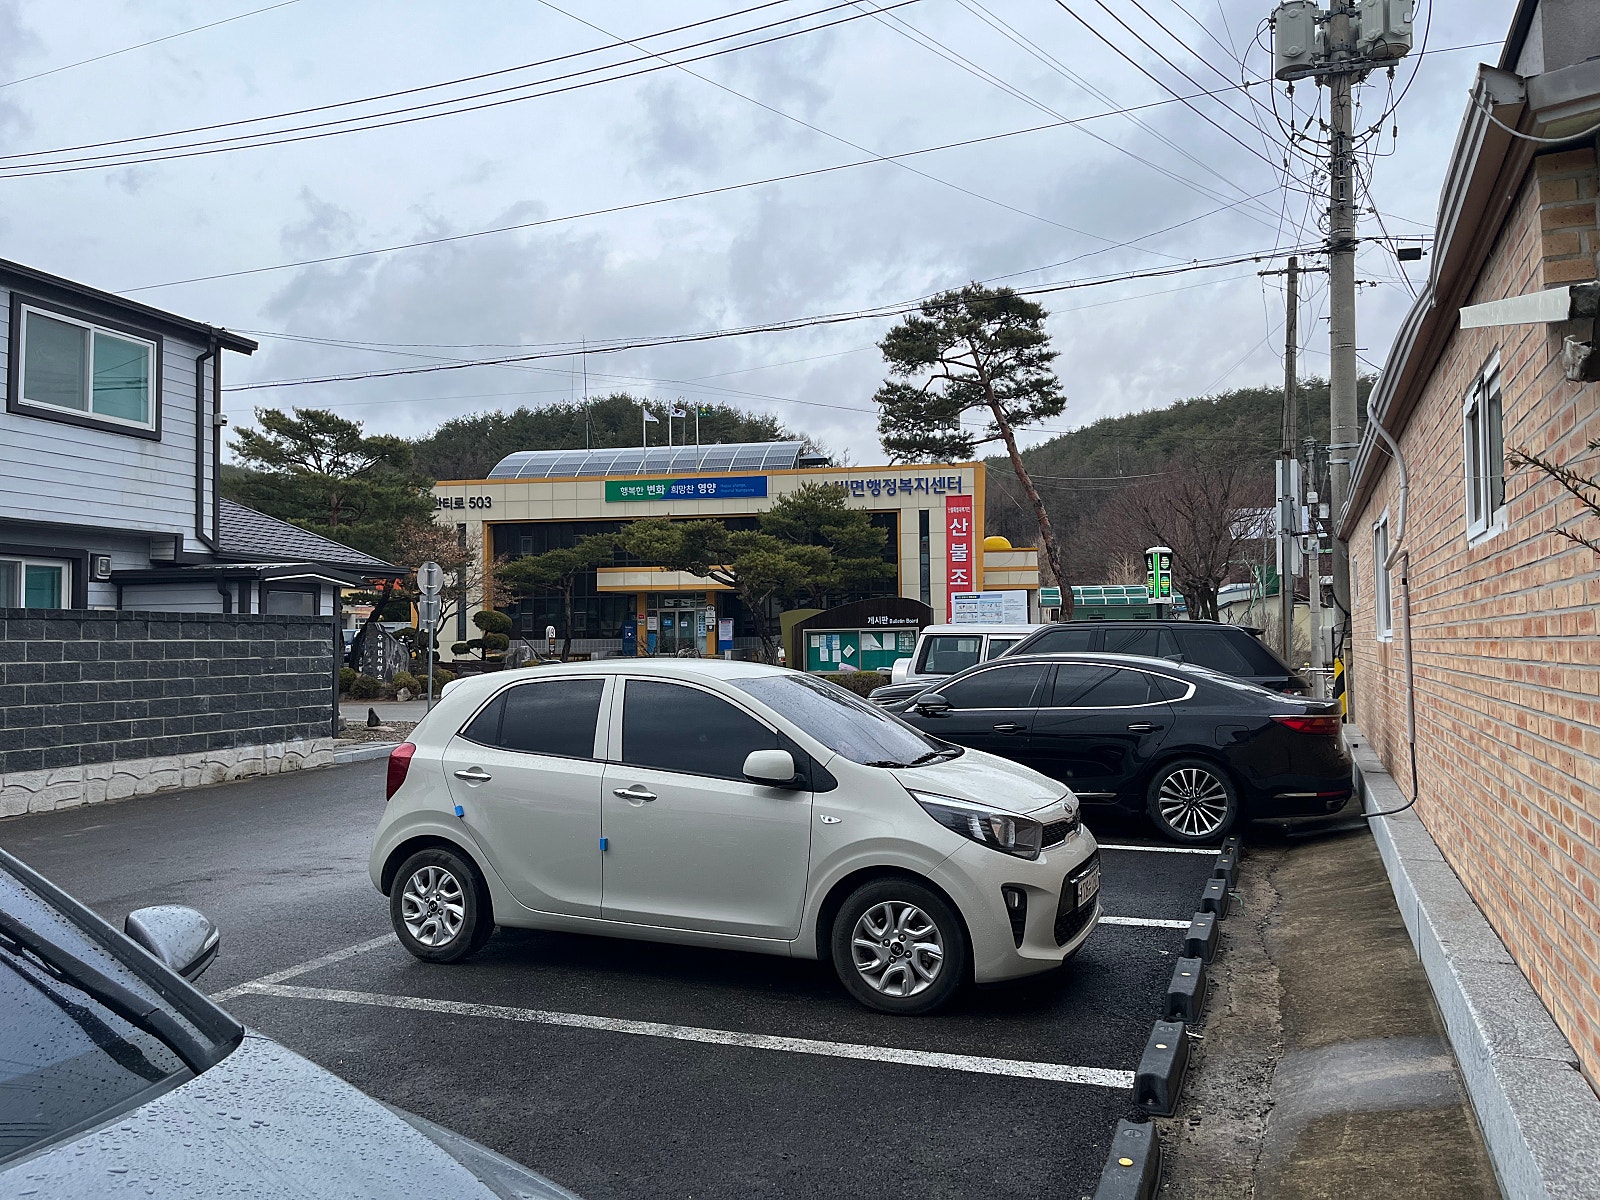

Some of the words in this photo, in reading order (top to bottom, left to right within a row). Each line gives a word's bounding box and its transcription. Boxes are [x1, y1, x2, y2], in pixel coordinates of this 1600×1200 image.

[620, 486, 644, 496] 행복한
[646, 484, 665, 495] 변화
[670, 484, 695, 494] 희망찬
[697, 482, 717, 494] 영양
[823, 475, 962, 498] 면행정복지센터
[468, 496, 492, 509] 503
[867, 615, 889, 625] 게시판
